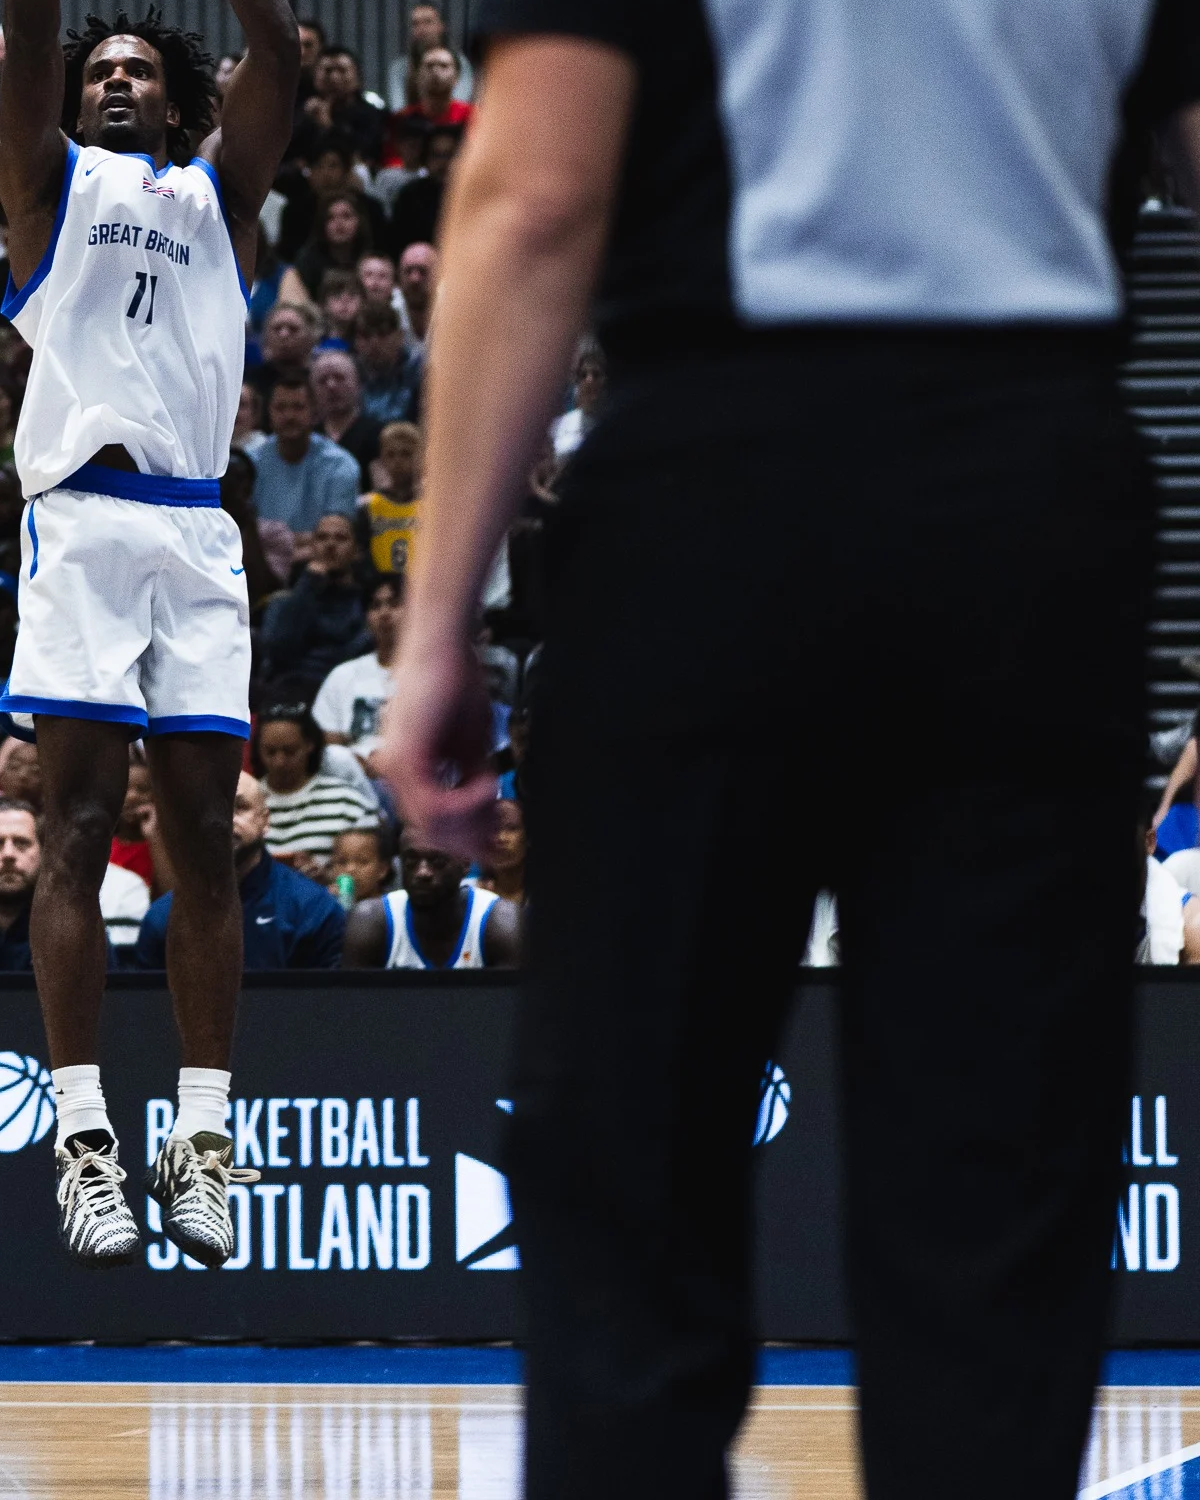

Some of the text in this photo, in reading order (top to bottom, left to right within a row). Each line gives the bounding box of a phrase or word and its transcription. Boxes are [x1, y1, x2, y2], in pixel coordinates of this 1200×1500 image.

[88, 222, 190, 266] GREAT BRTAIN
[126, 271, 158, 325] 11
[146, 1097, 431, 1167] BKETBALL
[146, 1184, 431, 1270] SOTLAND
